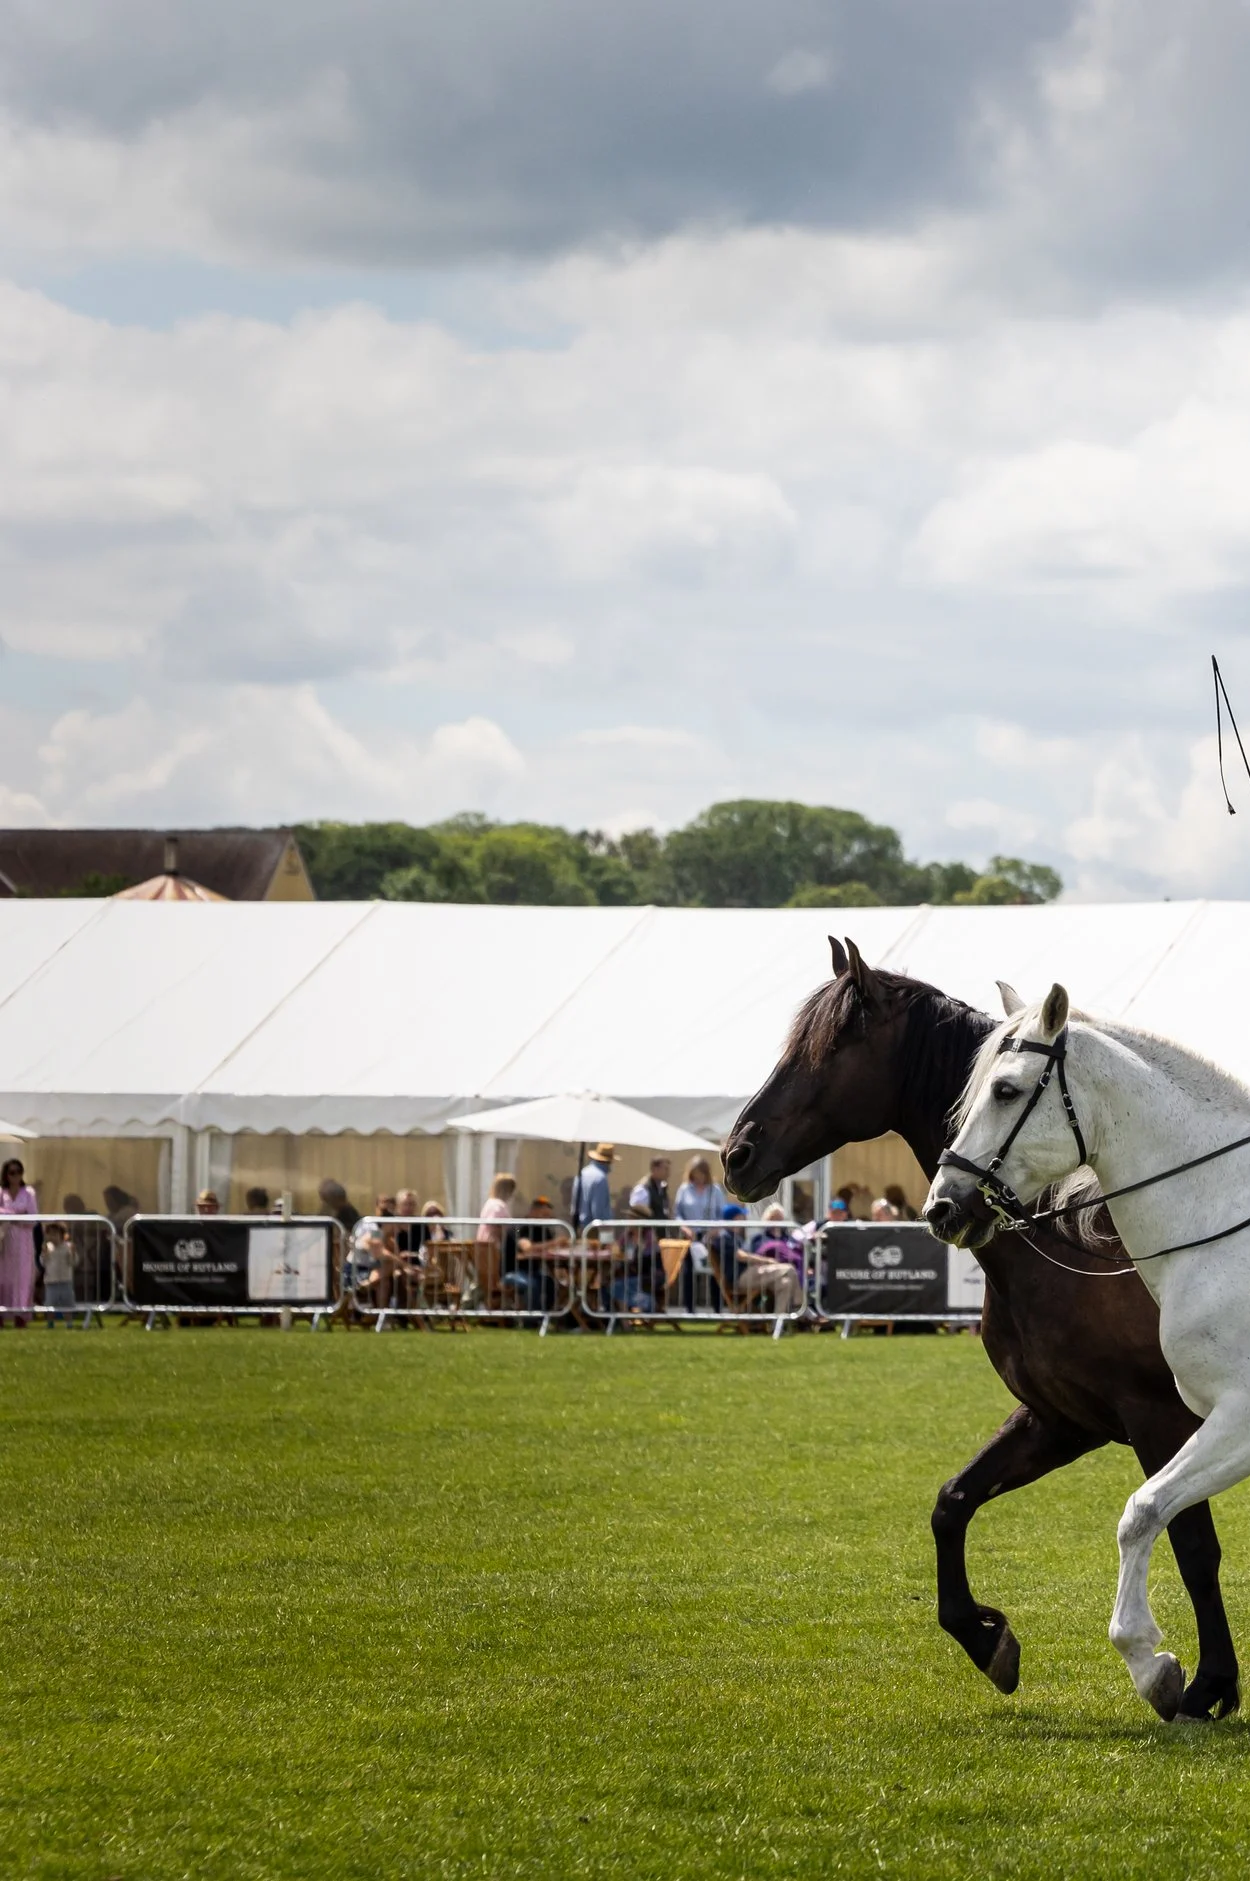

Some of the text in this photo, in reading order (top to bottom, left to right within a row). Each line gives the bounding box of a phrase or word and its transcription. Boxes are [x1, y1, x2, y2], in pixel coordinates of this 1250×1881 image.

[142, 1262, 238, 1273] HOUSE OF RUTLAND
[836, 1269, 938, 1280] HOUSE OF RUTLAND
